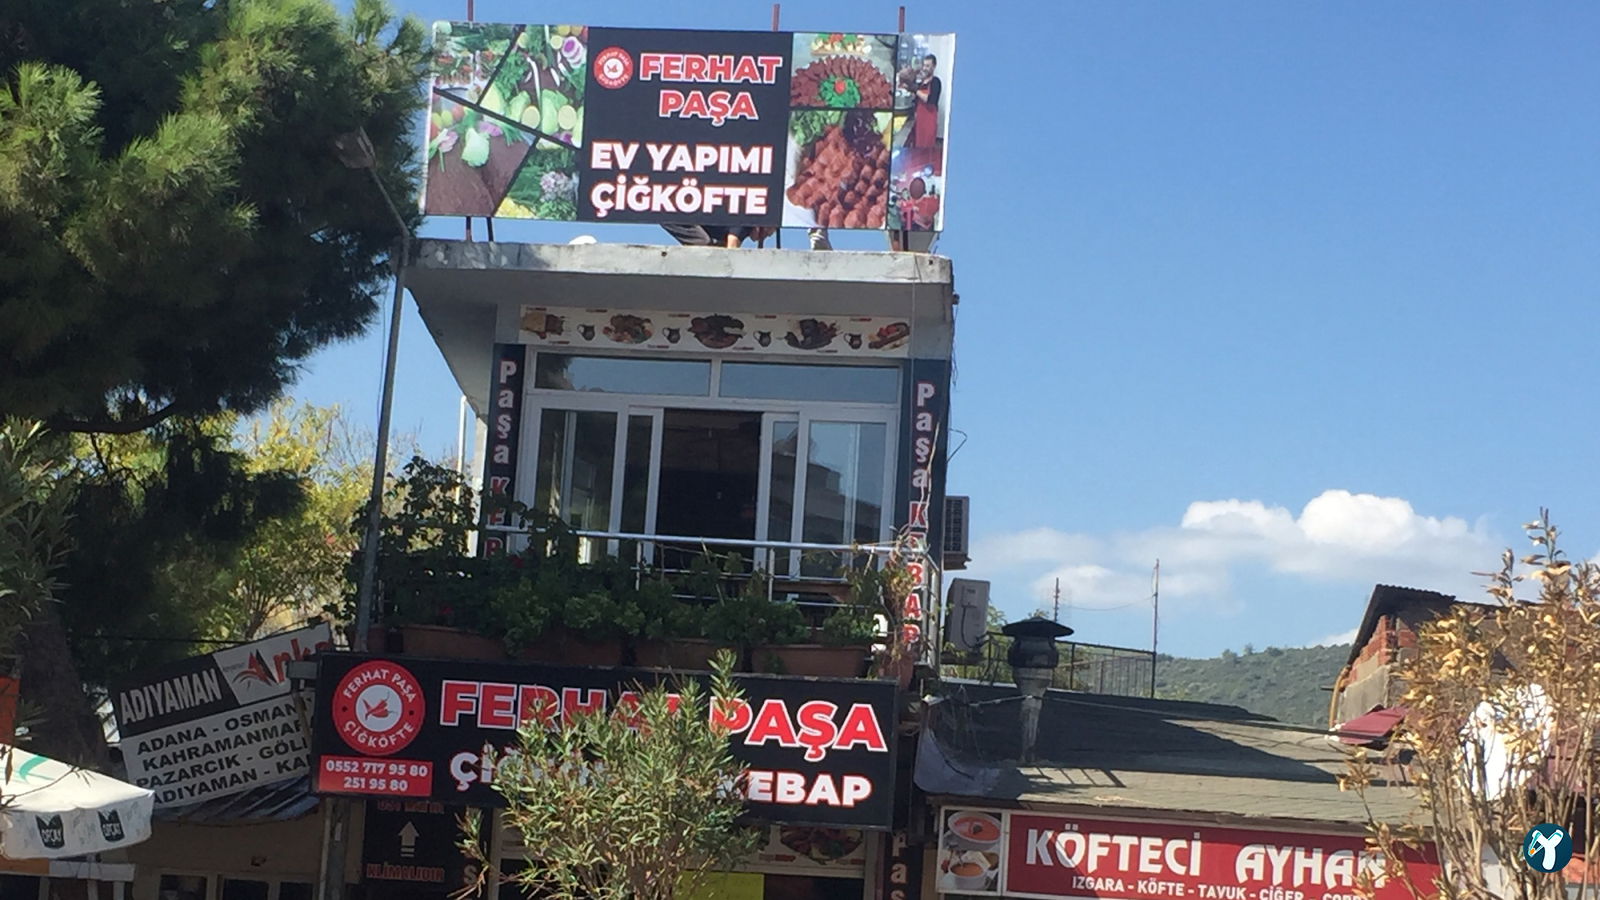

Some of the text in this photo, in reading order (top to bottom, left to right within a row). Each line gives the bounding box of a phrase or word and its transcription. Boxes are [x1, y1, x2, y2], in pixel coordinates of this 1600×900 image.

[639, 53, 783, 84] FERHAT
[659, 90, 759, 126] PAŞA
[591, 141, 773, 174] EV YAPIMI
[590, 174, 768, 218] ÇİĞKÖFTE
[493, 360, 517, 465] Paşa
[912, 383, 935, 488] Paşa
[119, 668, 223, 726] ADIYAMAN
[343, 669, 416, 703] FERHAT PAŞA
[137, 726, 207, 755] ADANA
[224, 703, 298, 731] OSMAN
[343, 720, 414, 748] ÇİĞKÖFTE
[709, 696, 888, 762] PAŞA
[136, 753, 241, 788] PAZARCIK
[259, 737, 308, 760] GÖL
[326, 760, 428, 777] 0552 717 95 80
[343, 777, 408, 791] 251 95 80
[716, 769, 873, 807] EBAP
[1025, 823, 1386, 889] KÖFTECİ AYHAN
[1072, 875, 1125, 892] IZGARA
[1137, 877, 1185, 897] KÖFTE
[1198, 884, 1246, 900] TAVUK
